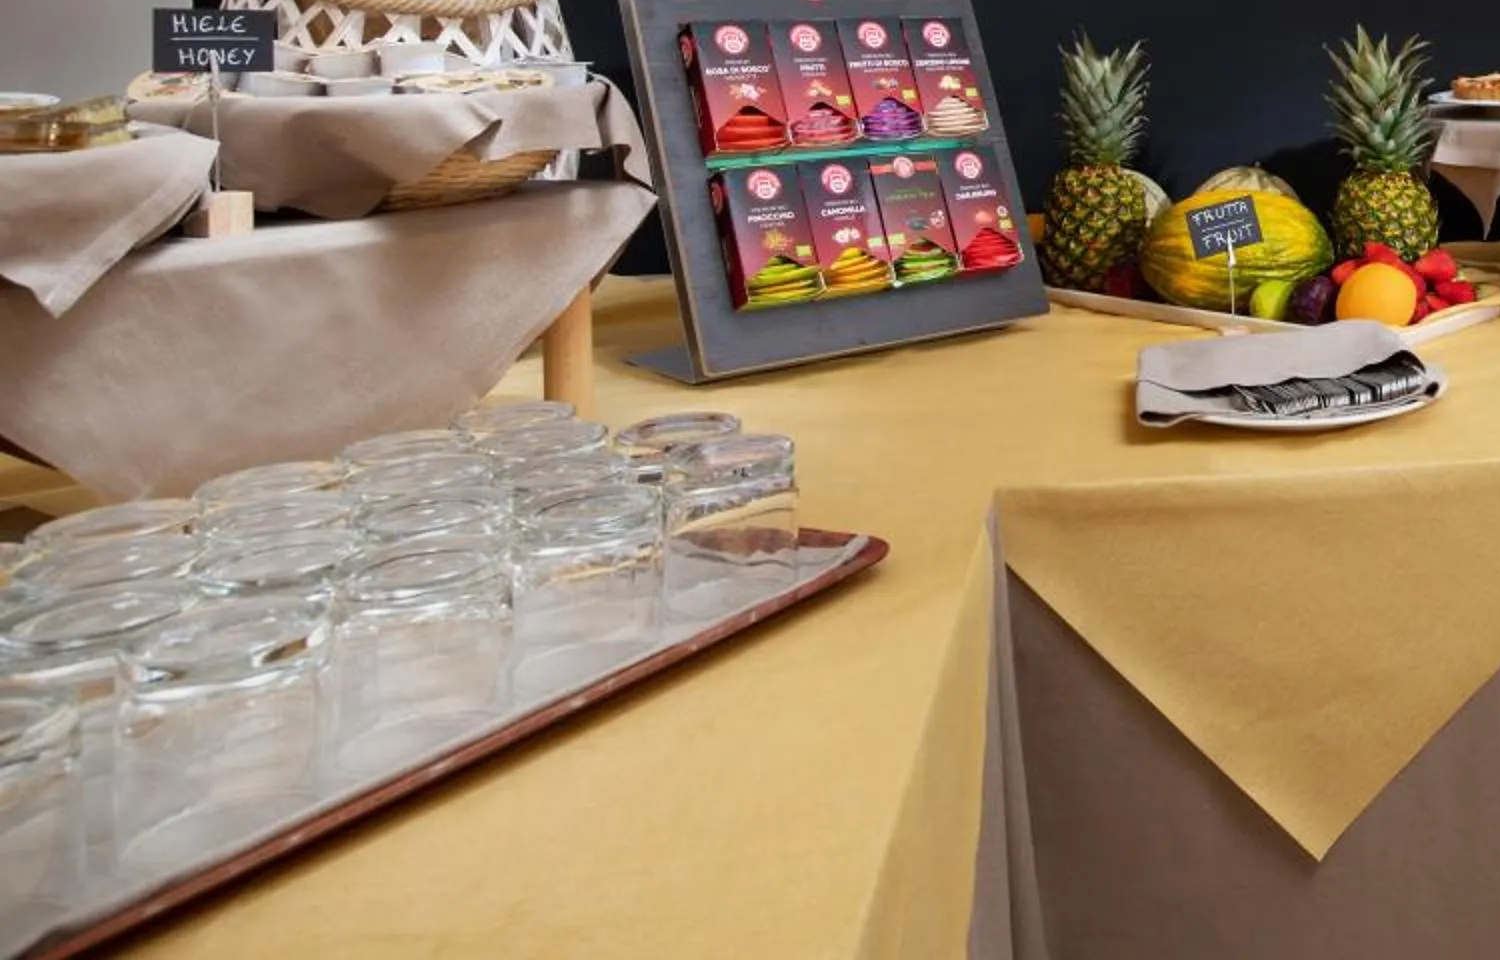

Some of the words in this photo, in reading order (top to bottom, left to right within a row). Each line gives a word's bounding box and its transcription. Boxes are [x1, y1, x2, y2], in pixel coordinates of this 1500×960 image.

[177, 47, 256, 66] HONEY
[820, 205, 866, 218] CAMOMILLA
[1190, 200, 1250, 227] FRUTTA
[1201, 223, 1253, 250] FRUIT
